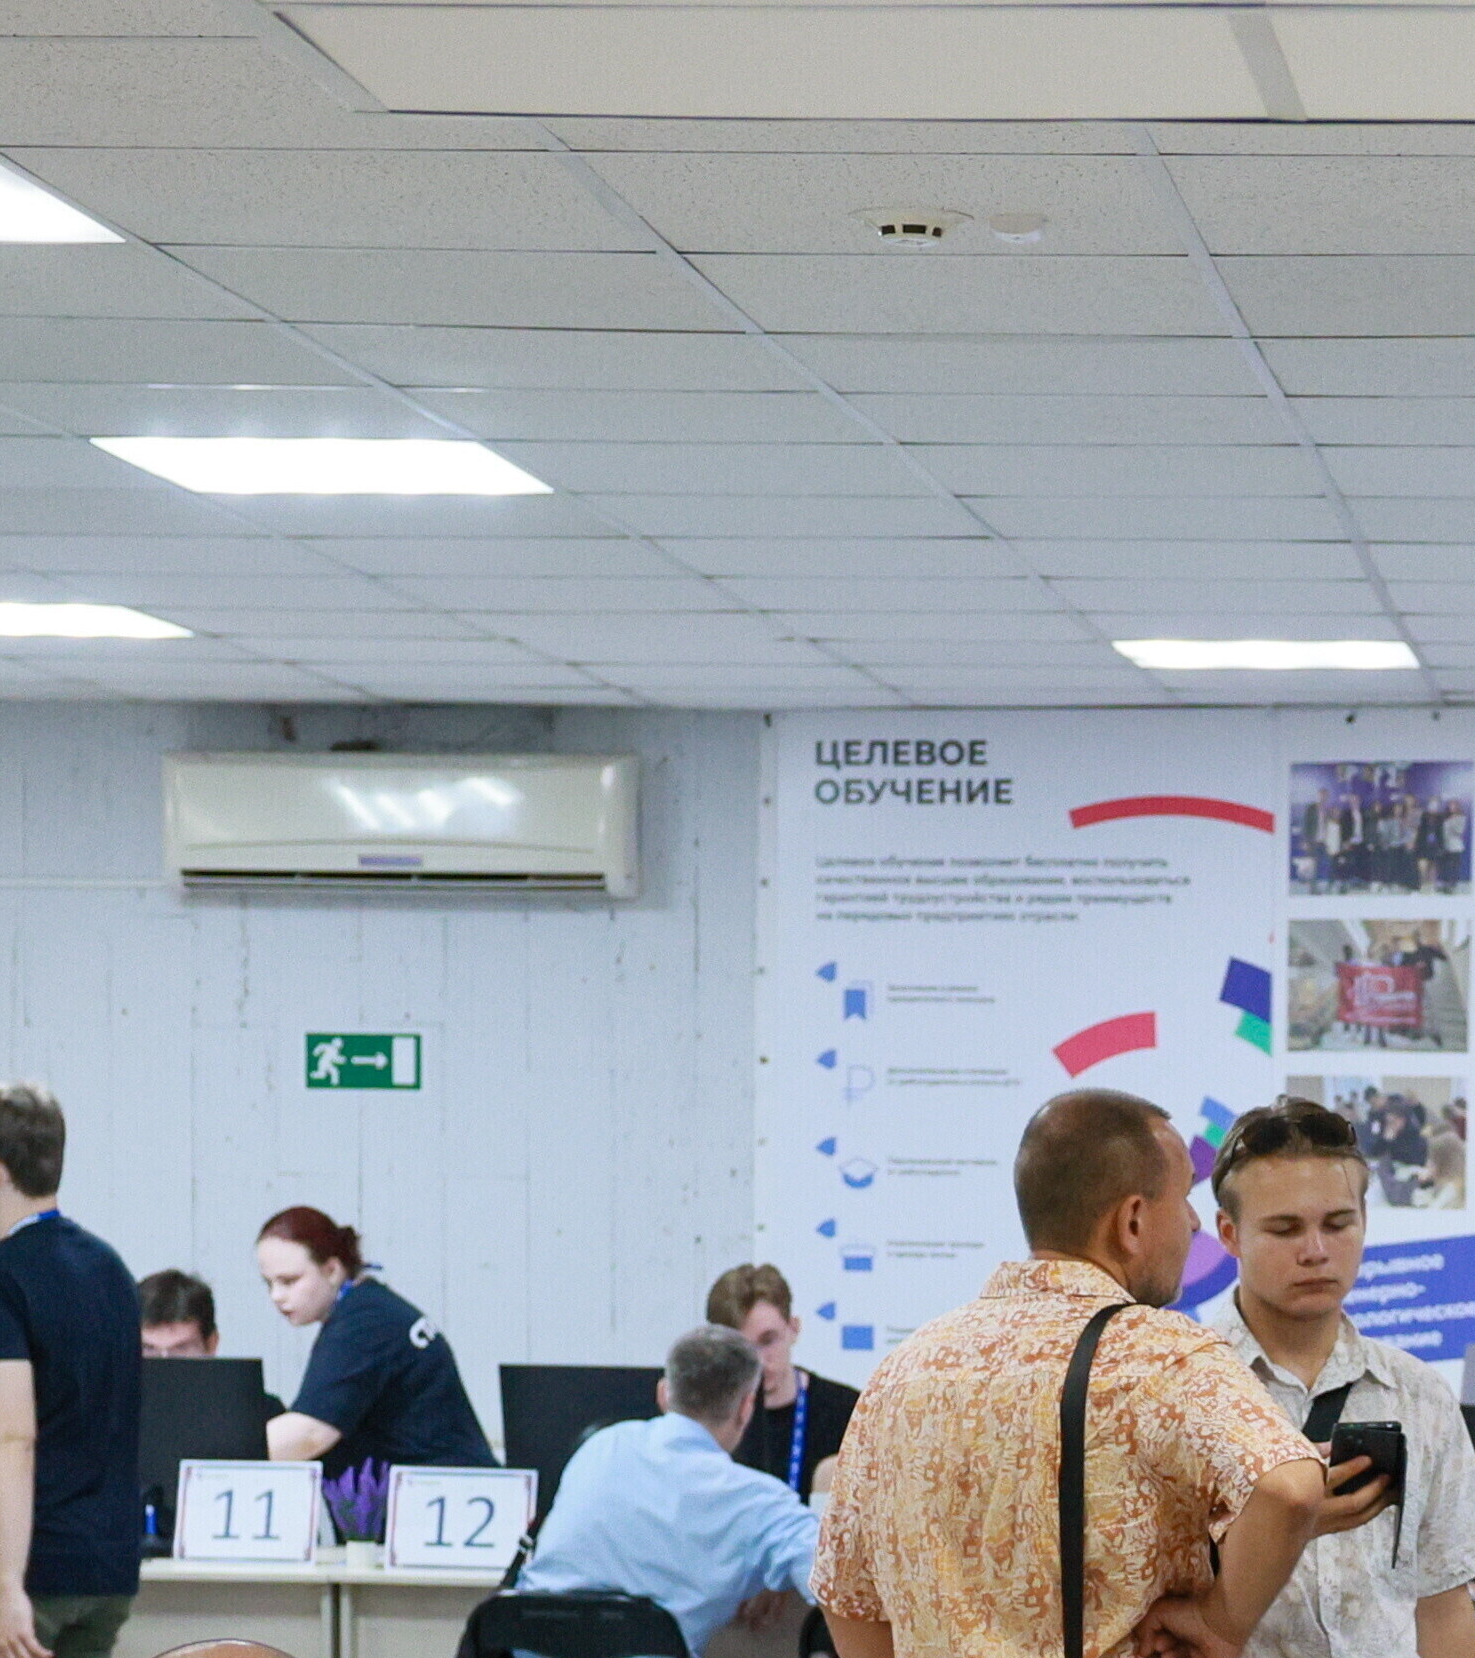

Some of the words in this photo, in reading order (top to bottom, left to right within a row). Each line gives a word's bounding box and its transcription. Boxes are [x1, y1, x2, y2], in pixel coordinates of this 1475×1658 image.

[815, 740, 988, 771] ЦЕЛЕВОЕ
[814, 778, 1013, 805] ОБУЧЕНИЕ
[212, 1488, 281, 1540] 11
[424, 1495, 496, 1549] 12
